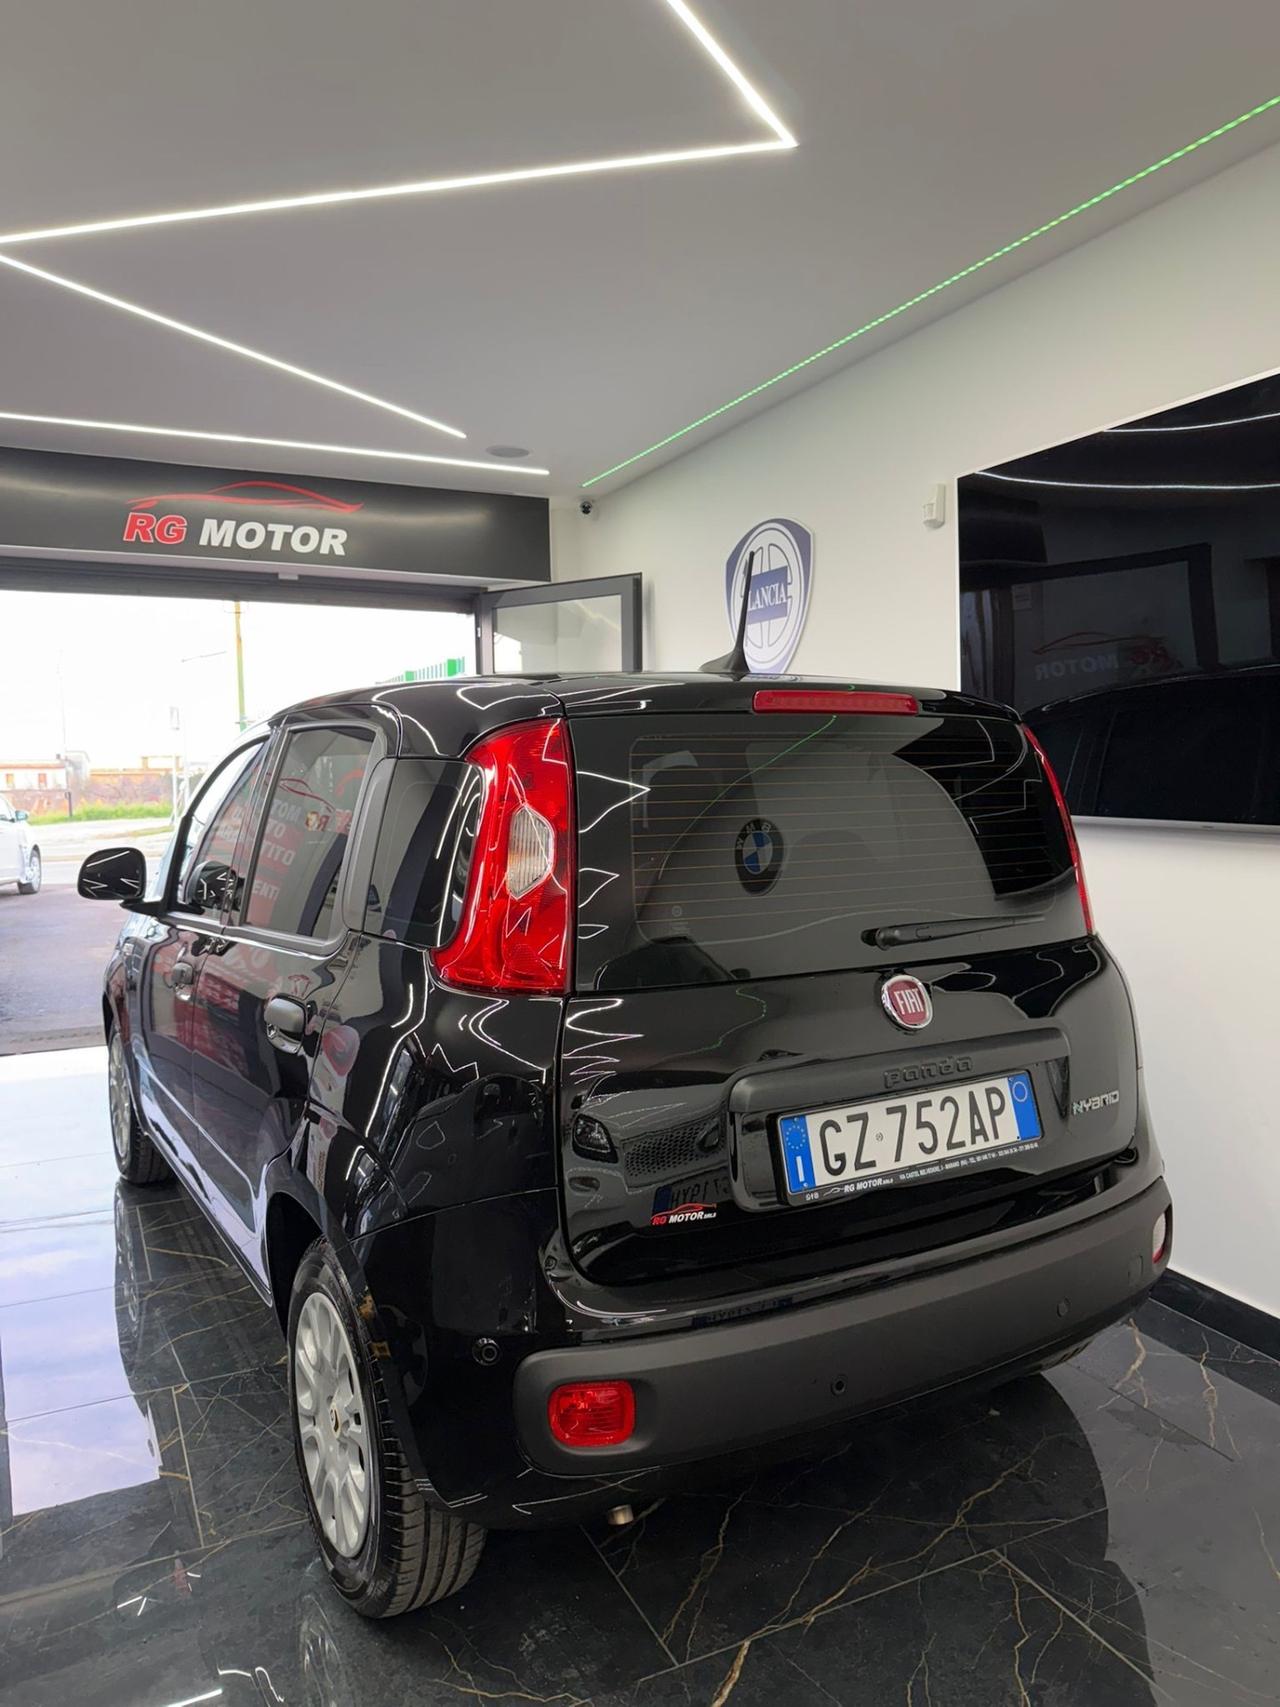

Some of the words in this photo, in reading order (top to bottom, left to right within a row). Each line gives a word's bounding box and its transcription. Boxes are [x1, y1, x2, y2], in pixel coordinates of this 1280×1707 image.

[123, 512, 188, 544] RG
[199, 518, 348, 556] MOTOR
[748, 583, 787, 611] LANCIA
[893, 988, 925, 1015] FIAT
[856, 1177, 883, 1192] MOTOR
[668, 1211, 705, 1224] MOTOR
